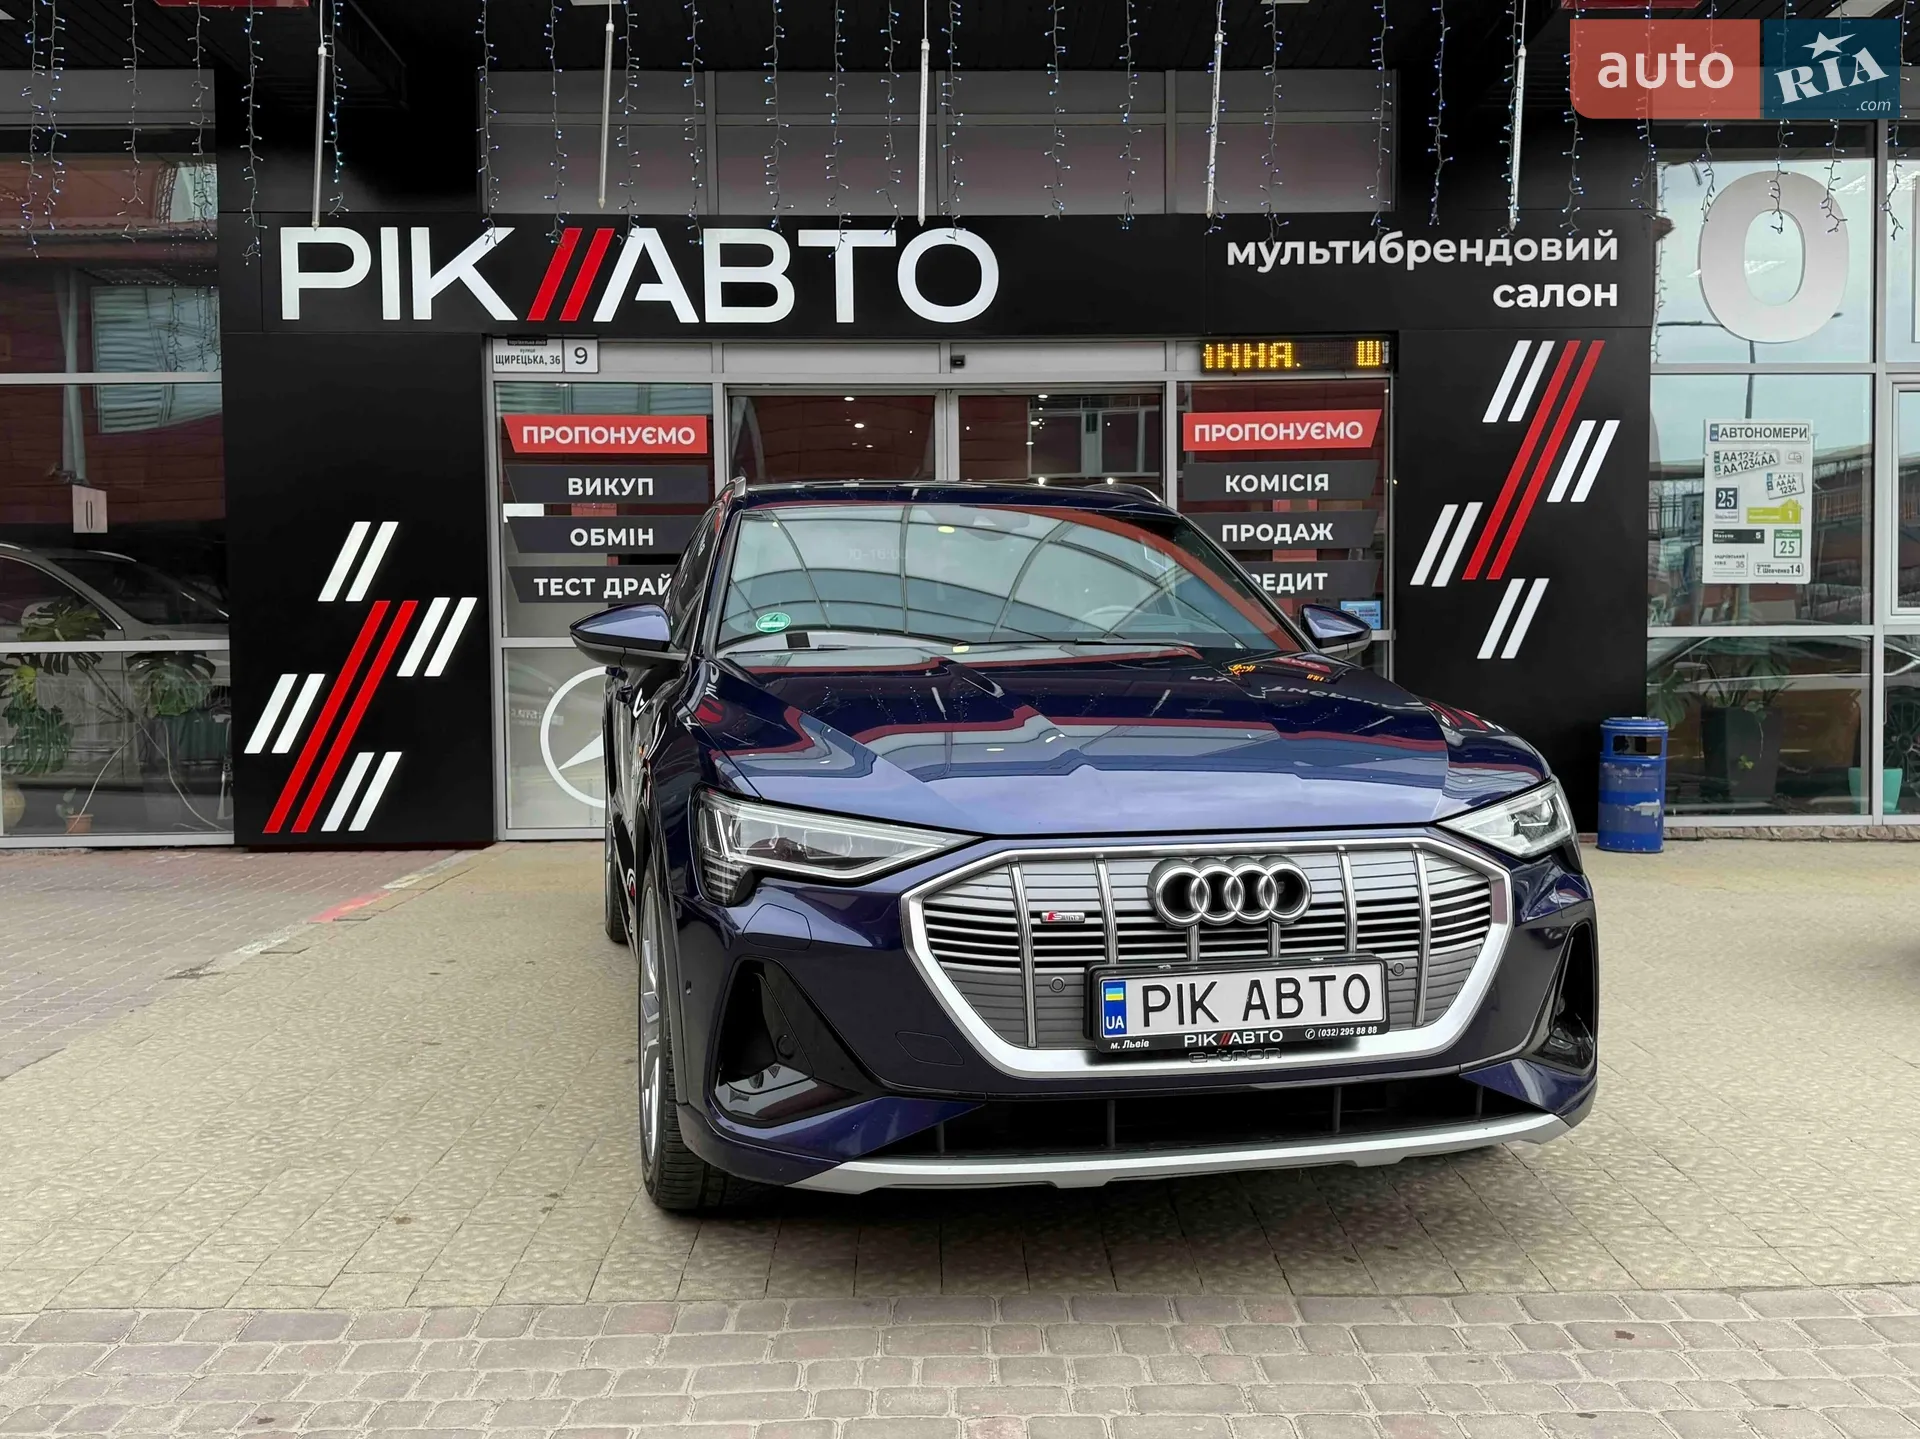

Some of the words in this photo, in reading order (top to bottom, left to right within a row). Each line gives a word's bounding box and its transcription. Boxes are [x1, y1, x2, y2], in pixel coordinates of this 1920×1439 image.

[1227, 229, 1618, 273] мультибрендовий
[1493, 283, 1618, 308] салон
[495, 355, 548, 366] ЩИРЕЦЬКА,
[549, 355, 561, 365] 36
[574, 347, 588, 365] 9
[522, 426, 696, 445] ПРОПОНУЄМО
[1194, 421, 1363, 442] ПРОПОНУЄМО
[1720, 427, 1808, 438] АВТОНОМЕРИ
[568, 478, 653, 496] ВИКУП
[1225, 473, 1329, 492] КОМІСІЯ
[1718, 490, 1735, 508] 25
[570, 528, 654, 546] ОБМІН
[1222, 523, 1334, 544] ПРОДАЖ
[1780, 540, 1795, 554] 25
[1790, 564, 1801, 574] 14
[533, 578, 596, 596] ТЕСТ
[603, 573, 672, 599] ДРАЙ
[1250, 572, 1328, 593] ЕДИТ
[1142, 981, 1219, 1027] РІК
[1242, 973, 1371, 1022] АВТО
[1105, 1016, 1124, 1029] UA
[1317, 1028, 1338, 1038] (032)
[1340, 1027, 1354, 1036] 295
[1356, 1026, 1365, 1035] 88
[1367, 1025, 1377, 1034] 88
[1110, 1042, 1121, 1050] м.
[1122, 1039, 1149, 1049] Львів
[1188, 1048, 1282, 1063] e-tron
